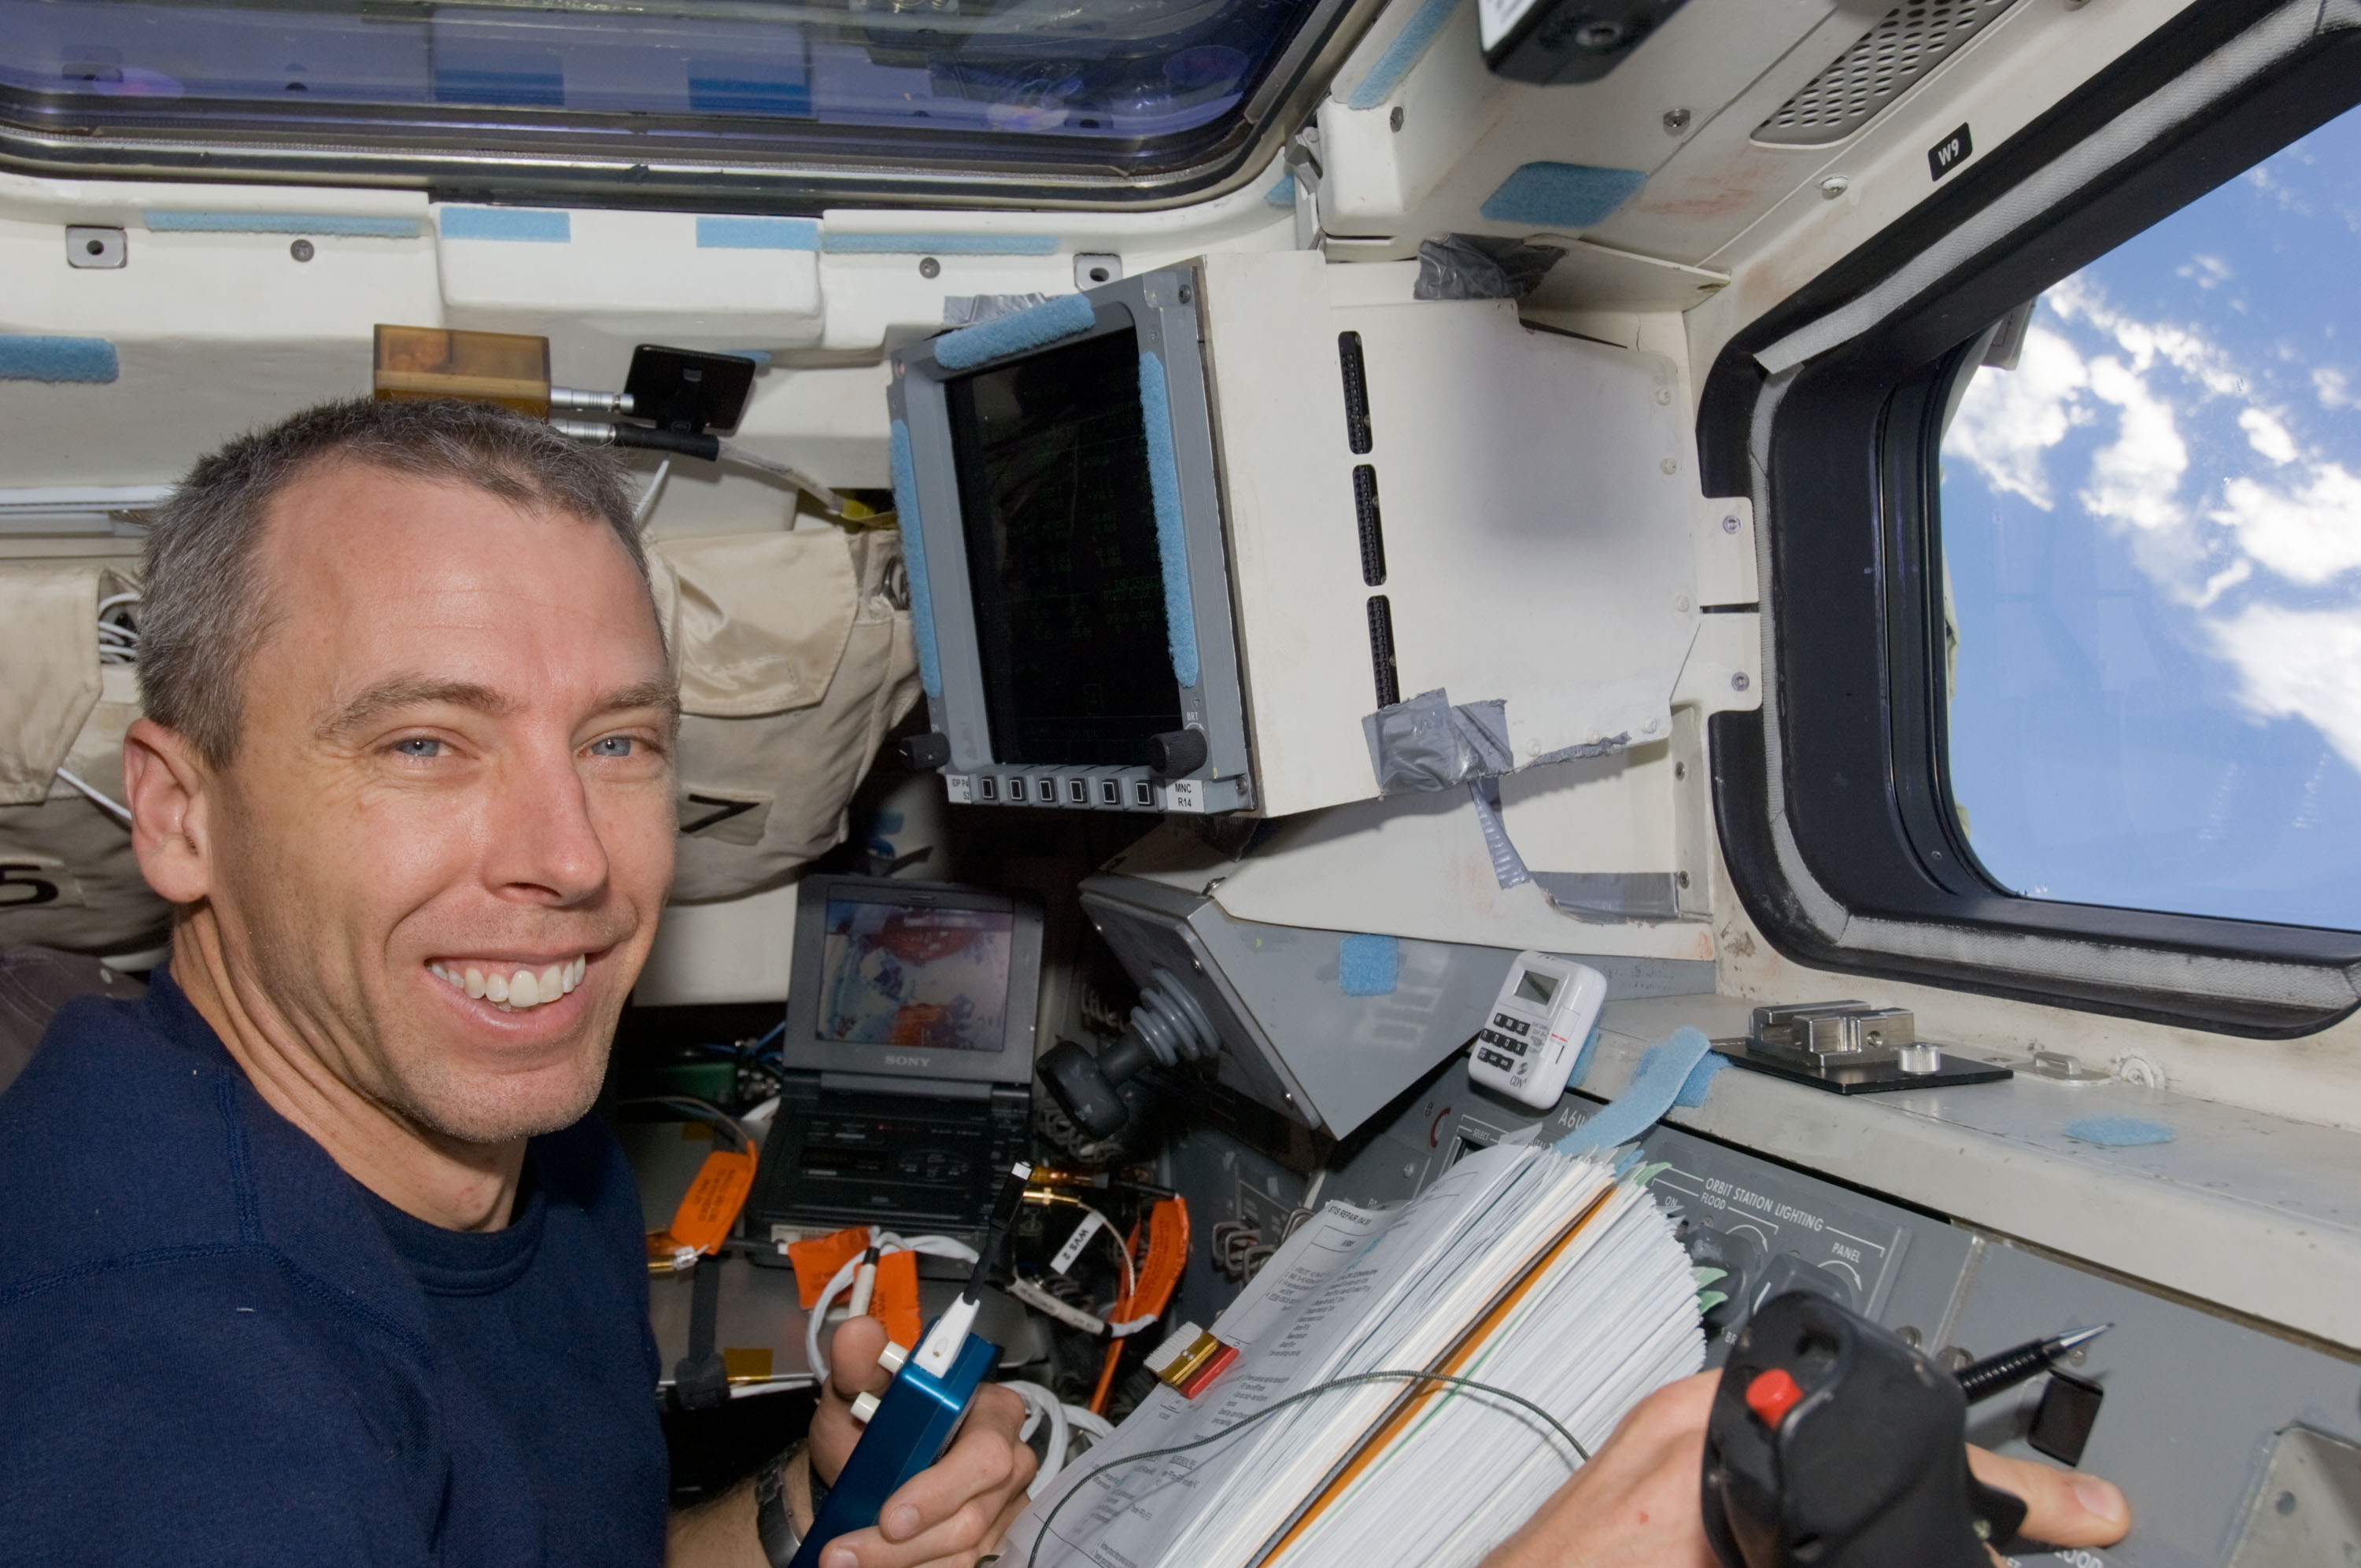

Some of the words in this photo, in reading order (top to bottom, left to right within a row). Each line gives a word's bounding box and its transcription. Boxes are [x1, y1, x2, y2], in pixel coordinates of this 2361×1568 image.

[1938, 138, 1960, 166] W9
[1186, 711, 1199, 721] BRT
[1175, 782, 1192, 794] MNC
[1177, 797, 1192, 808] R14
[0, 863, 60, 907] 5
[885, 1054, 931, 1068] SONY
[1472, 1127, 1491, 1142] SELECT
[1665, 1196, 1678, 1207] ON
[1700, 1192, 1726, 1210] FLOOD
[1705, 1177, 1734, 1197] ORBIT
[1733, 1186, 1774, 1212] STATION
[1775, 1202, 1824, 1232] LIGHTING
[1339, 1209, 1359, 1223] REPAIR
[1832, 1241, 1862, 1263] PANEL
